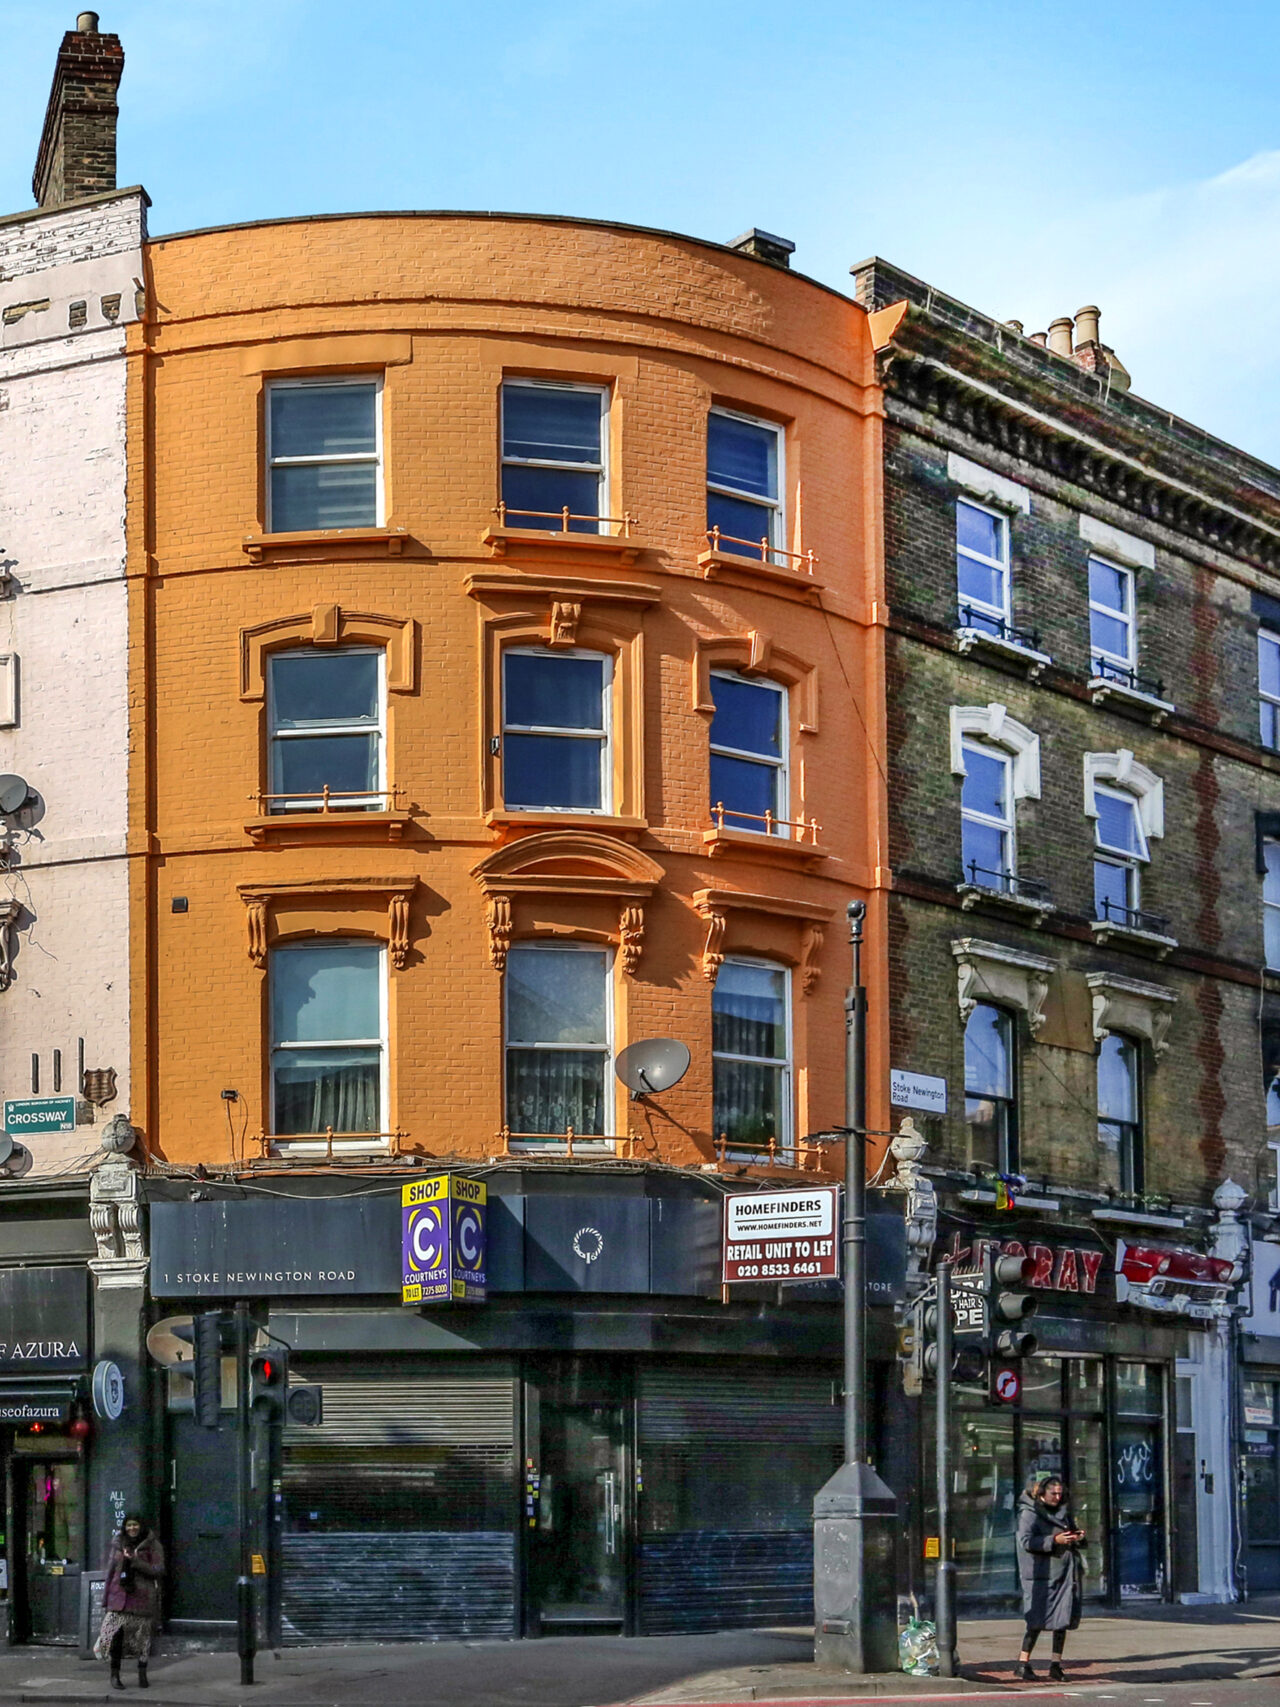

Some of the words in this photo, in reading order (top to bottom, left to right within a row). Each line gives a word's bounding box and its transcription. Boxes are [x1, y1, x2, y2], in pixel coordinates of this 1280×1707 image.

[892, 1081, 911, 1094] Stoke
[913, 1085, 945, 1100] Newington
[892, 1092, 909, 1103] Road
[7, 1110, 68, 1125] CROSSWAY
[410, 1180, 440, 1202] SHOP
[456, 1180, 480, 1200] SHOP
[735, 1199, 822, 1216] HOMEFINDERS
[737, 1220, 823, 1232] WWW.HOMEFINDERS.NET
[413, 1217, 435, 1261] C
[460, 1217, 477, 1260] C
[727, 1244, 763, 1261] RETAIL
[765, 1242, 793, 1259] UNIT
[795, 1241, 812, 1258] TO
[813, 1240, 833, 1256] LET
[164, 1273, 169, 1283] 1
[177, 1273, 220, 1283] STOKE
[226, 1271, 312, 1283] NEWINGTON
[318, 1270, 356, 1281] ROAD
[404, 1268, 448, 1285] COURTNEYS
[453, 1268, 486, 1284] COURTNEYS
[737, 1265, 759, 1277] 020
[761, 1263, 790, 1276] 8533
[793, 1262, 822, 1274] 6461
[958, 1298, 976, 1309] HAIR
[955, 1308, 984, 1326] PE
[10, 1341, 81, 1360] AZURA
[109, 1491, 126, 1502] ALL
[115, 1510, 126, 1519] US
